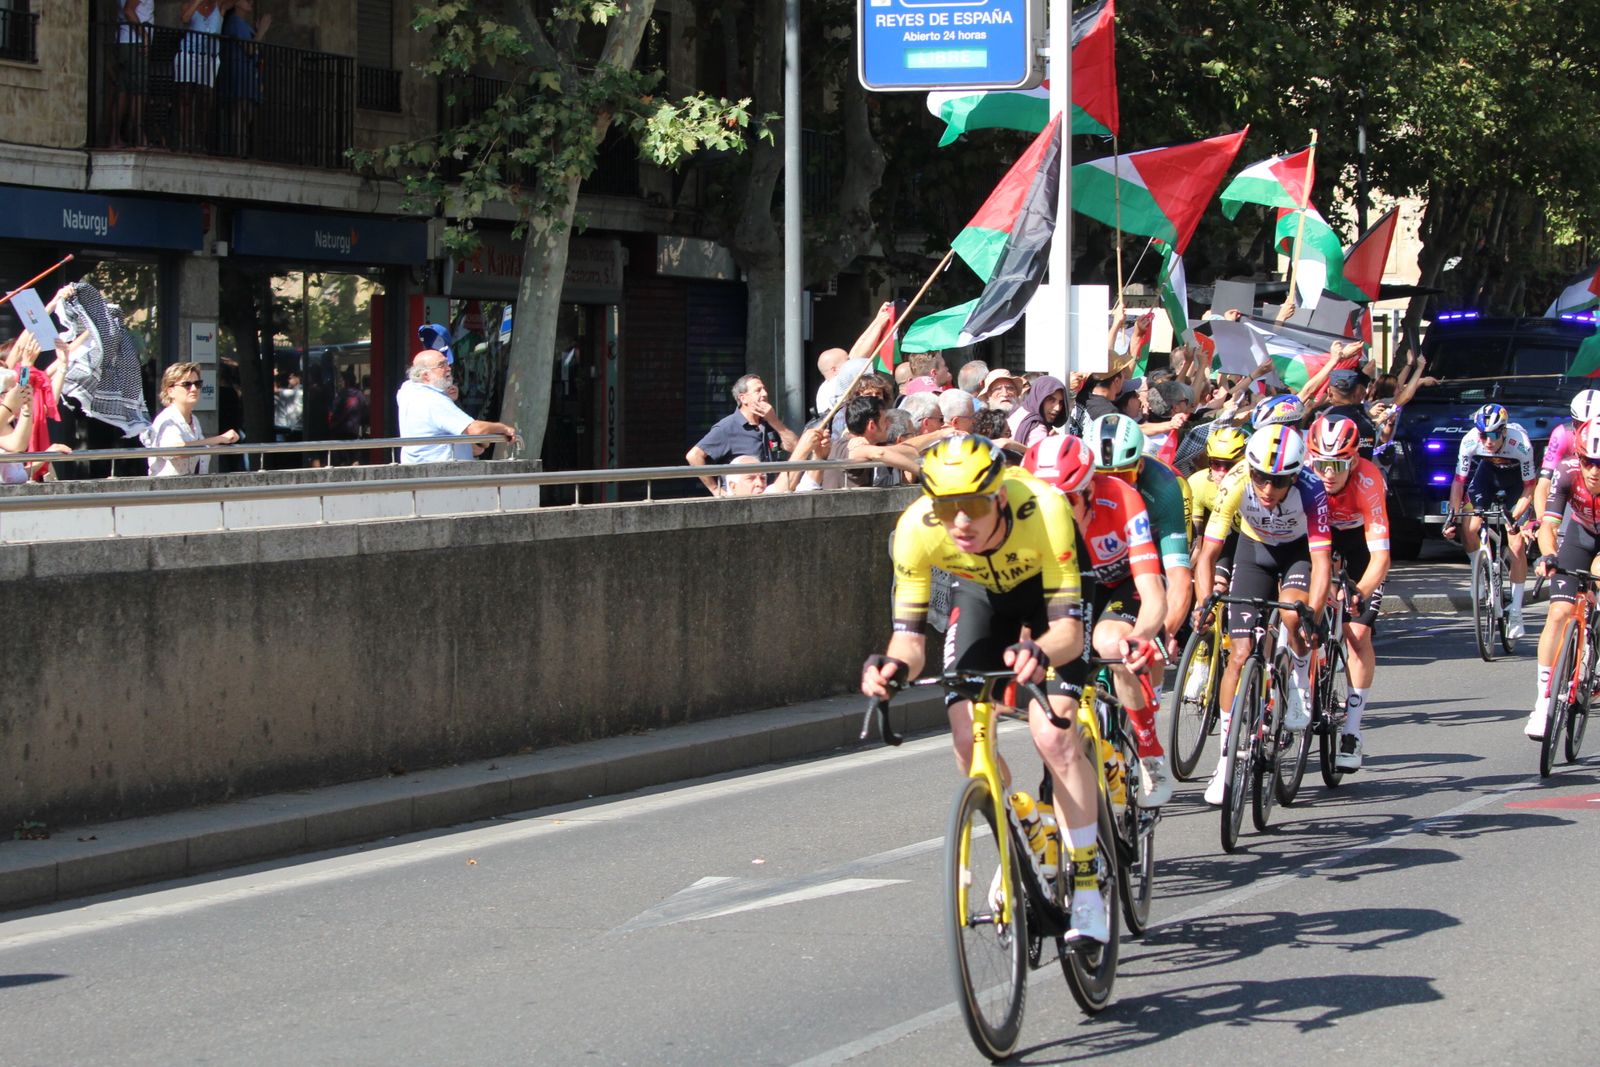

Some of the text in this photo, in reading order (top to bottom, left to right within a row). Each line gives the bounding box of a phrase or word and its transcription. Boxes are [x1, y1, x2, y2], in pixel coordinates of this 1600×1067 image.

[875, 8, 1013, 28] REYES DE ESPAÑA
[903, 30, 987, 42] Abierto 24 horas
[62, 208, 108, 236] Naturgy
[315, 230, 351, 254] Naturgy
[487, 245, 522, 277] Kawa
[607, 385, 616, 465] YMCO
[1246, 515, 1298, 528] INEOS
[1314, 490, 1330, 533] INEOS
[1367, 492, 1387, 534] INEOS
